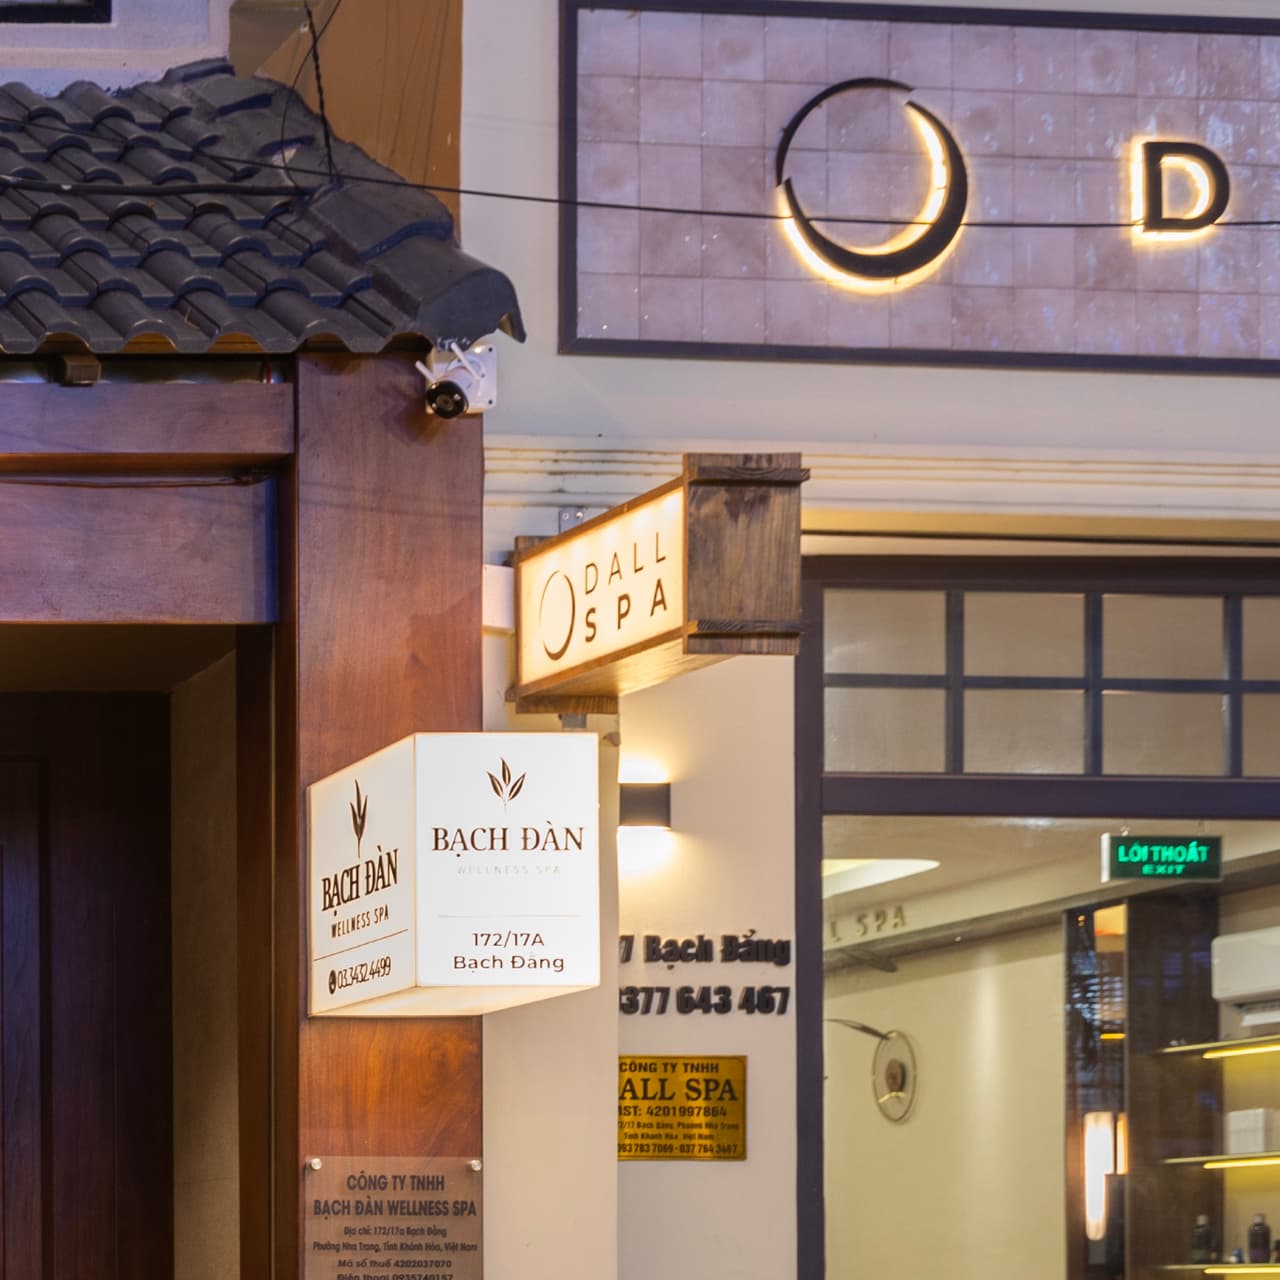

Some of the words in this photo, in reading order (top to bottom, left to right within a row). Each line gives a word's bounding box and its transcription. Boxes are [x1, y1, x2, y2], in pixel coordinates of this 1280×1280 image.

[1140, 140, 1230, 233] D
[584, 531, 667, 595] DALL
[584, 578, 668, 643] SPA
[431, 826, 509, 858] BẠCH
[521, 820, 584, 851] ĐÀN
[1150, 840, 1211, 862] THOÁT
[321, 864, 361, 917] BẠCH
[364, 844, 399, 896] ĐÀN
[1142, 864, 1186, 875] EXIT
[331, 910, 371, 939] WELLNESS
[374, 903, 390, 924] SPA
[855, 905, 908, 938] SPA
[471, 931, 545, 948] 172/17A
[644, 934, 714, 970] Bạch
[453, 954, 503, 974] Bạch
[618, 985, 671, 1016] 377
[676, 985, 733, 1015] 643
[737, 985, 791, 1016] 467
[662, 1062, 677, 1073] TY
[682, 1062, 720, 1073] TNHH
[684, 1077, 738, 1101] SPA
[646, 1105, 727, 1117] 4201997864
[346, 1170, 388, 1191] CÔNG
[392, 1174, 406, 1191] TY
[409, 1174, 445, 1191] TNHH
[313, 1198, 351, 1221] BẠCH
[354, 1195, 384, 1217] ĐÀN
[386, 1199, 449, 1217] WELLNESS
[452, 1199, 477, 1217] SPA
